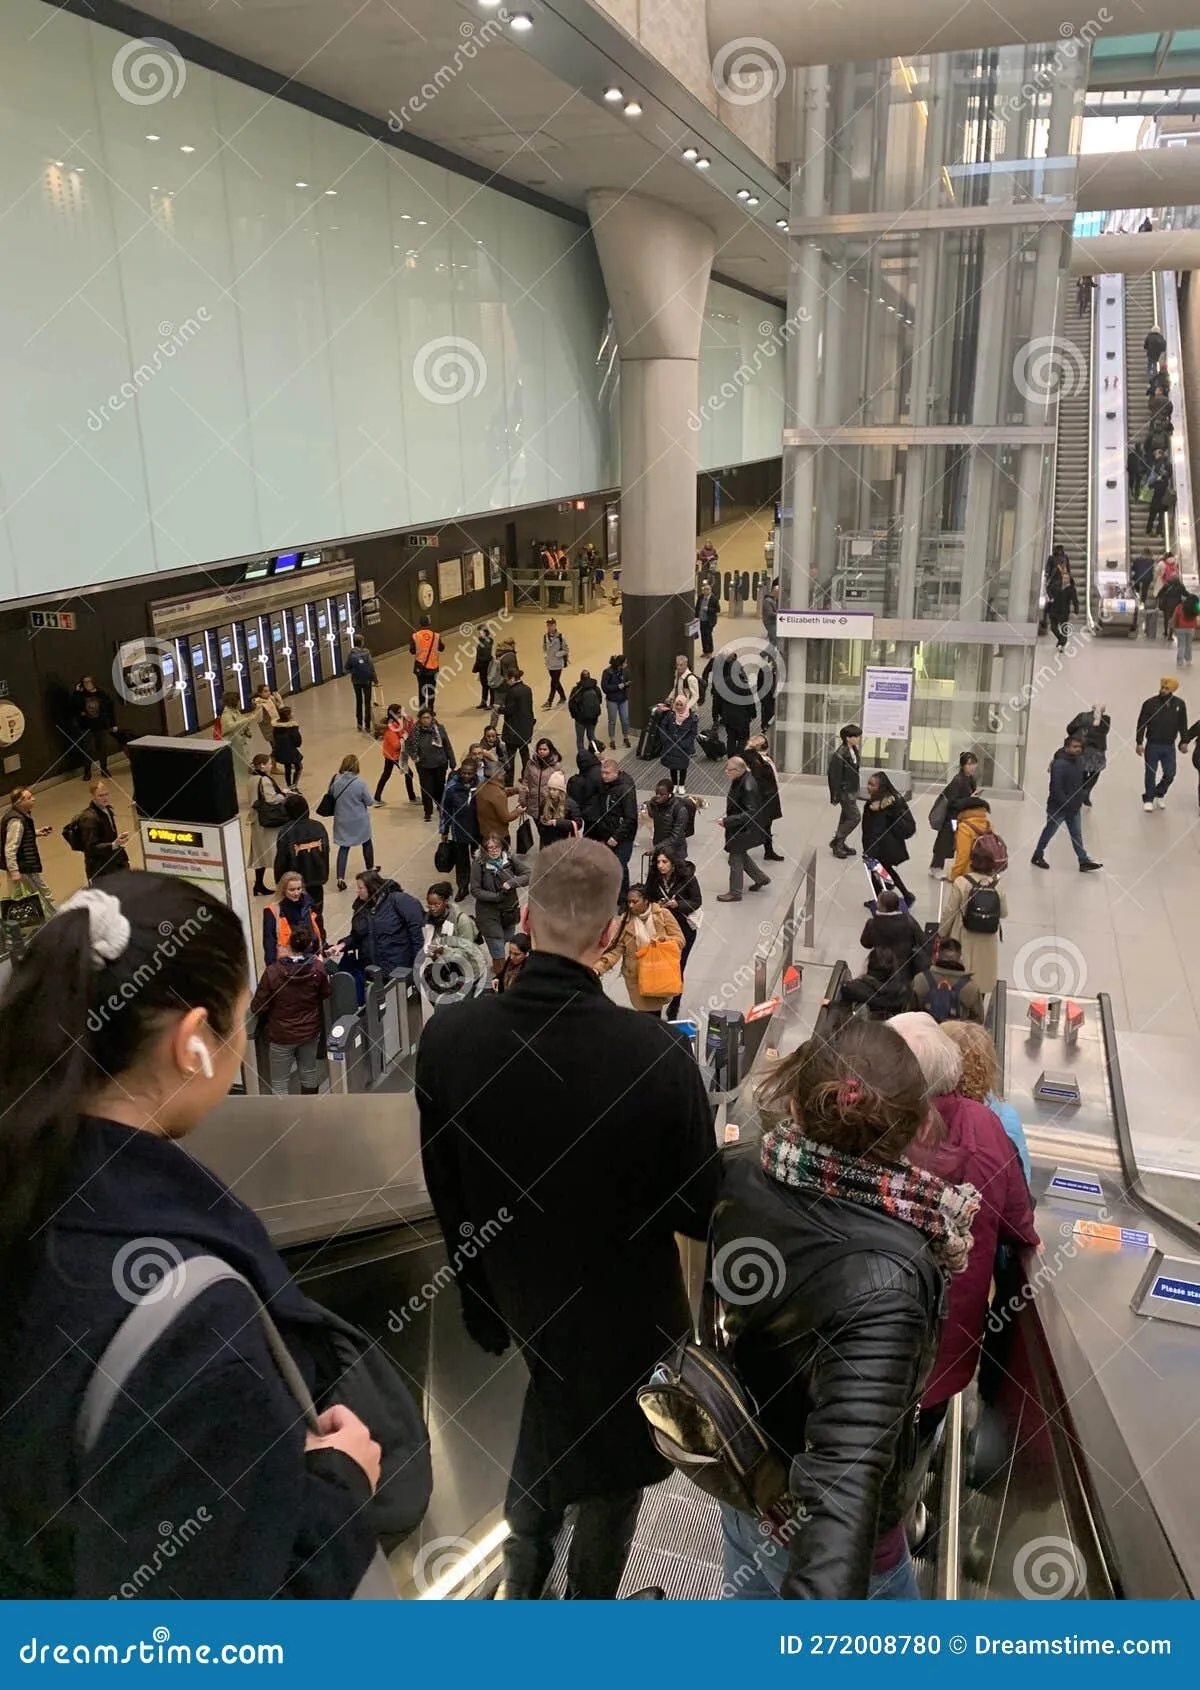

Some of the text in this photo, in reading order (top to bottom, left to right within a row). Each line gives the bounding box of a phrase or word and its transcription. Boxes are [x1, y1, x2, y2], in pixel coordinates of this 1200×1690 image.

[786, 616, 820, 624] Elizabeth
[157, 830, 193, 842] Way out
[1161, 1284, 1185, 1295] Please
